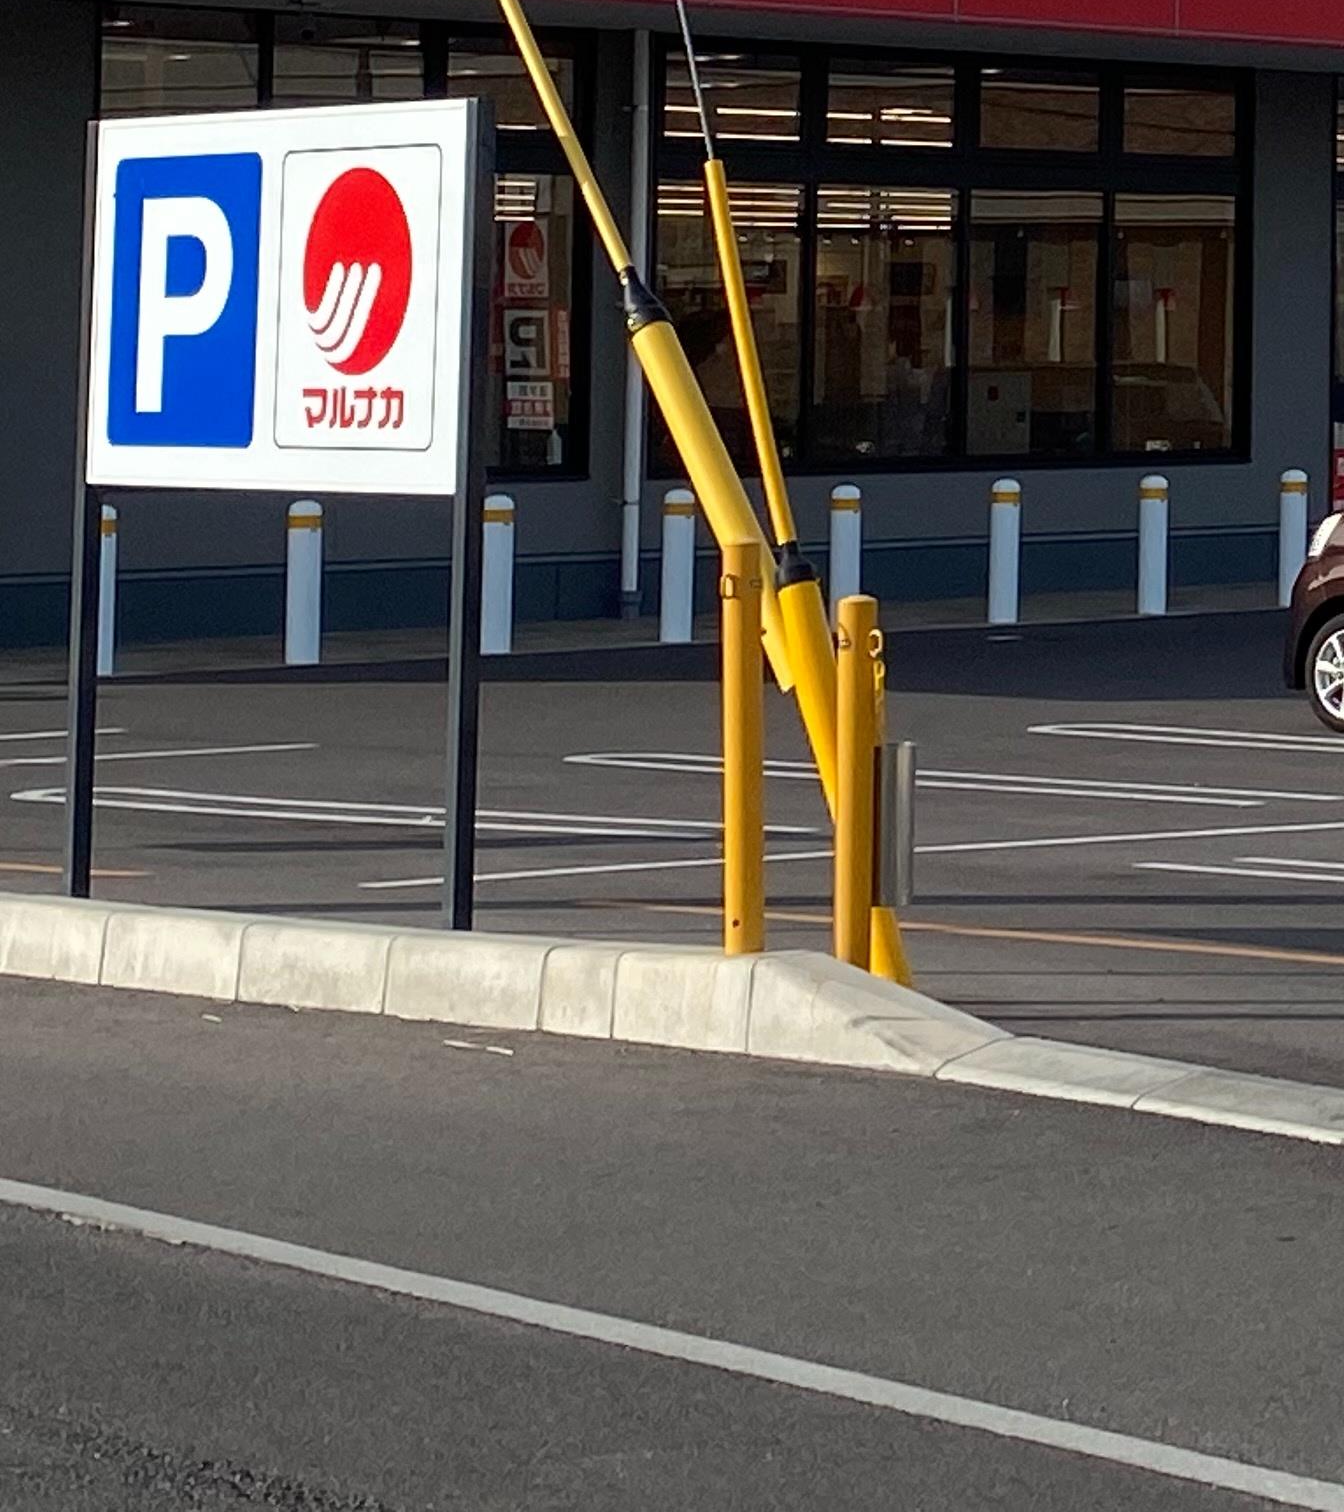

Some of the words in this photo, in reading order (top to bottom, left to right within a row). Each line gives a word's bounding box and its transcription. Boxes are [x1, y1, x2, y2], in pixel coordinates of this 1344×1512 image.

[135, 196, 235, 414] P
[302, 386, 405, 431] マルナカ
